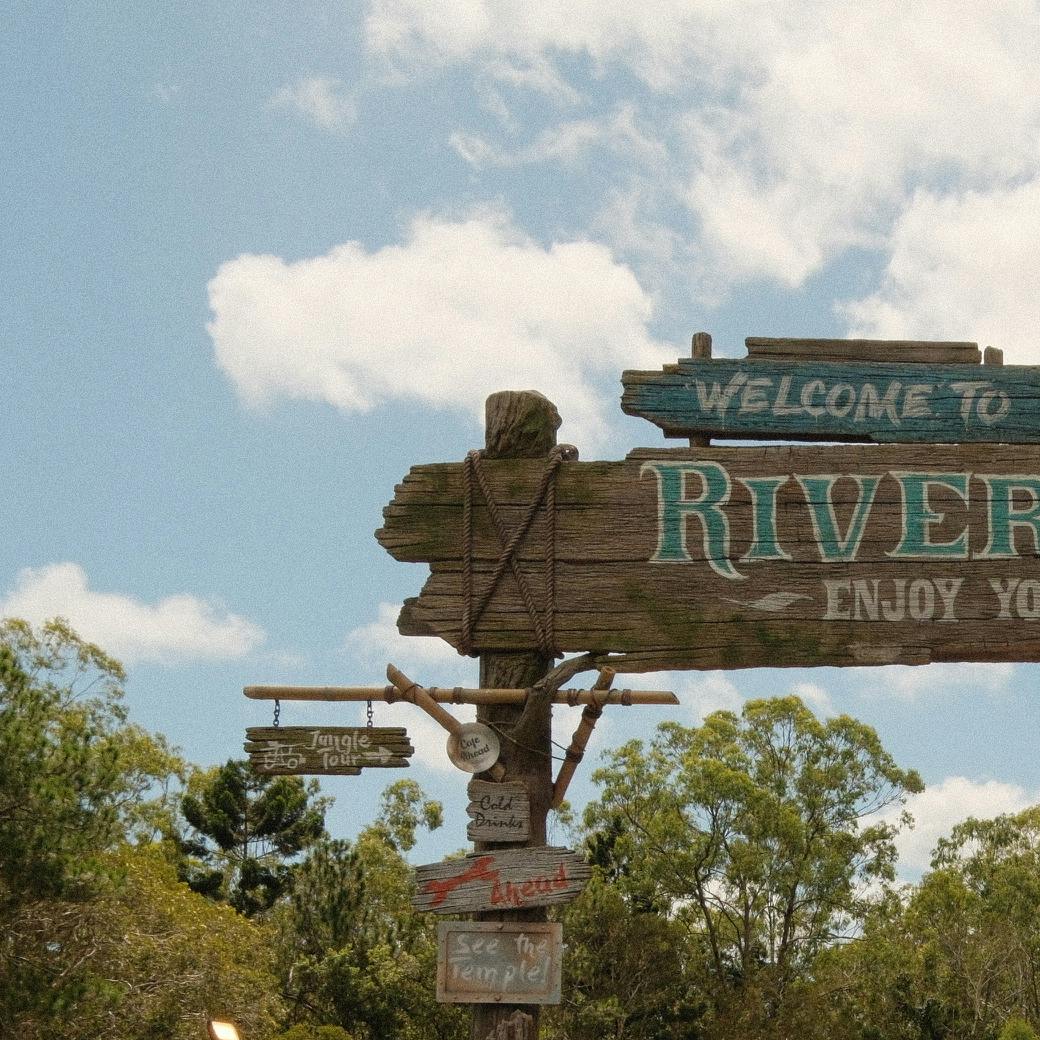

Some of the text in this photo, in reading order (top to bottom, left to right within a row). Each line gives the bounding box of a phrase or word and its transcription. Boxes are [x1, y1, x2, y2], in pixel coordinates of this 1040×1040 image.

[693, 372, 1012, 424] WELCOME TO
[822, 577, 966, 623] ENJOY
[305, 730, 372, 753] Jungle
[316, 746, 361, 769] Tour
[480, 795, 513, 811] Cold
[474, 812, 523, 828] Drinks
[457, 933, 549, 955] See the
